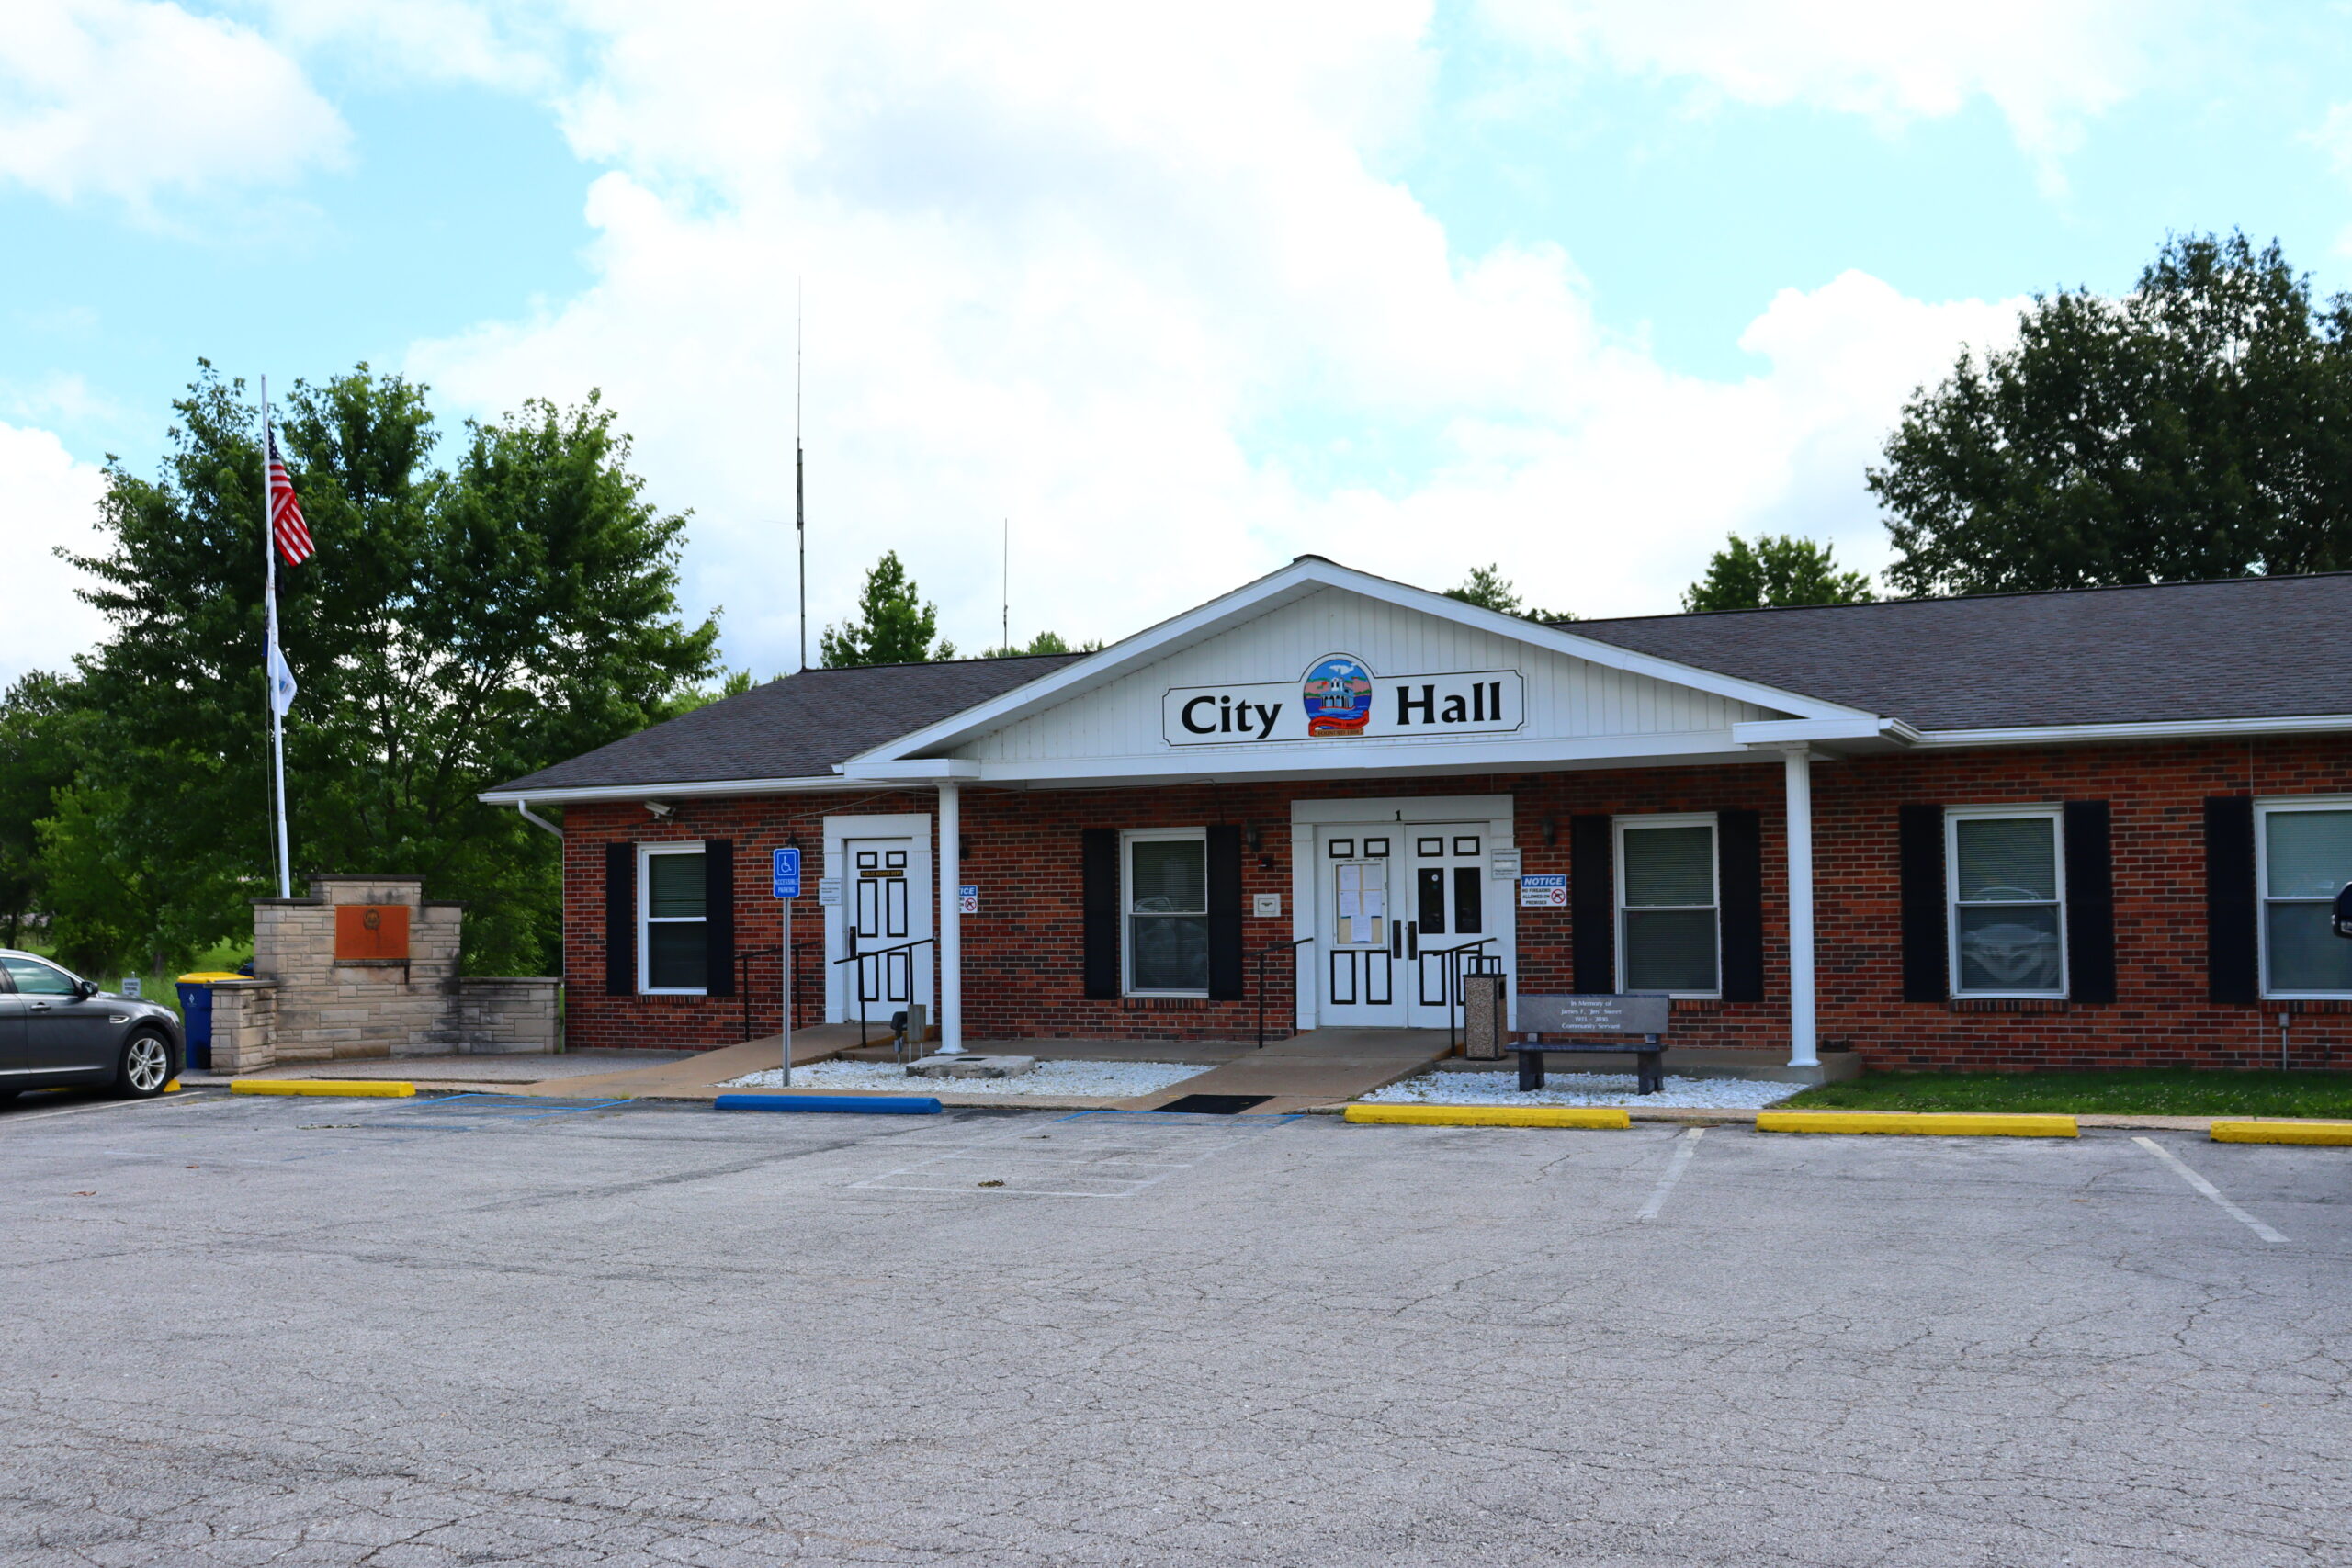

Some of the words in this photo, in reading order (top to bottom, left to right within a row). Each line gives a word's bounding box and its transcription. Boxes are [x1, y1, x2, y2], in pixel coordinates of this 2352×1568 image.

[1181, 695, 1283, 739] City
[1396, 682, 1501, 725] Hall
[1395, 809, 1401, 821] 1
[1523, 876, 1564, 886] NOTICE
